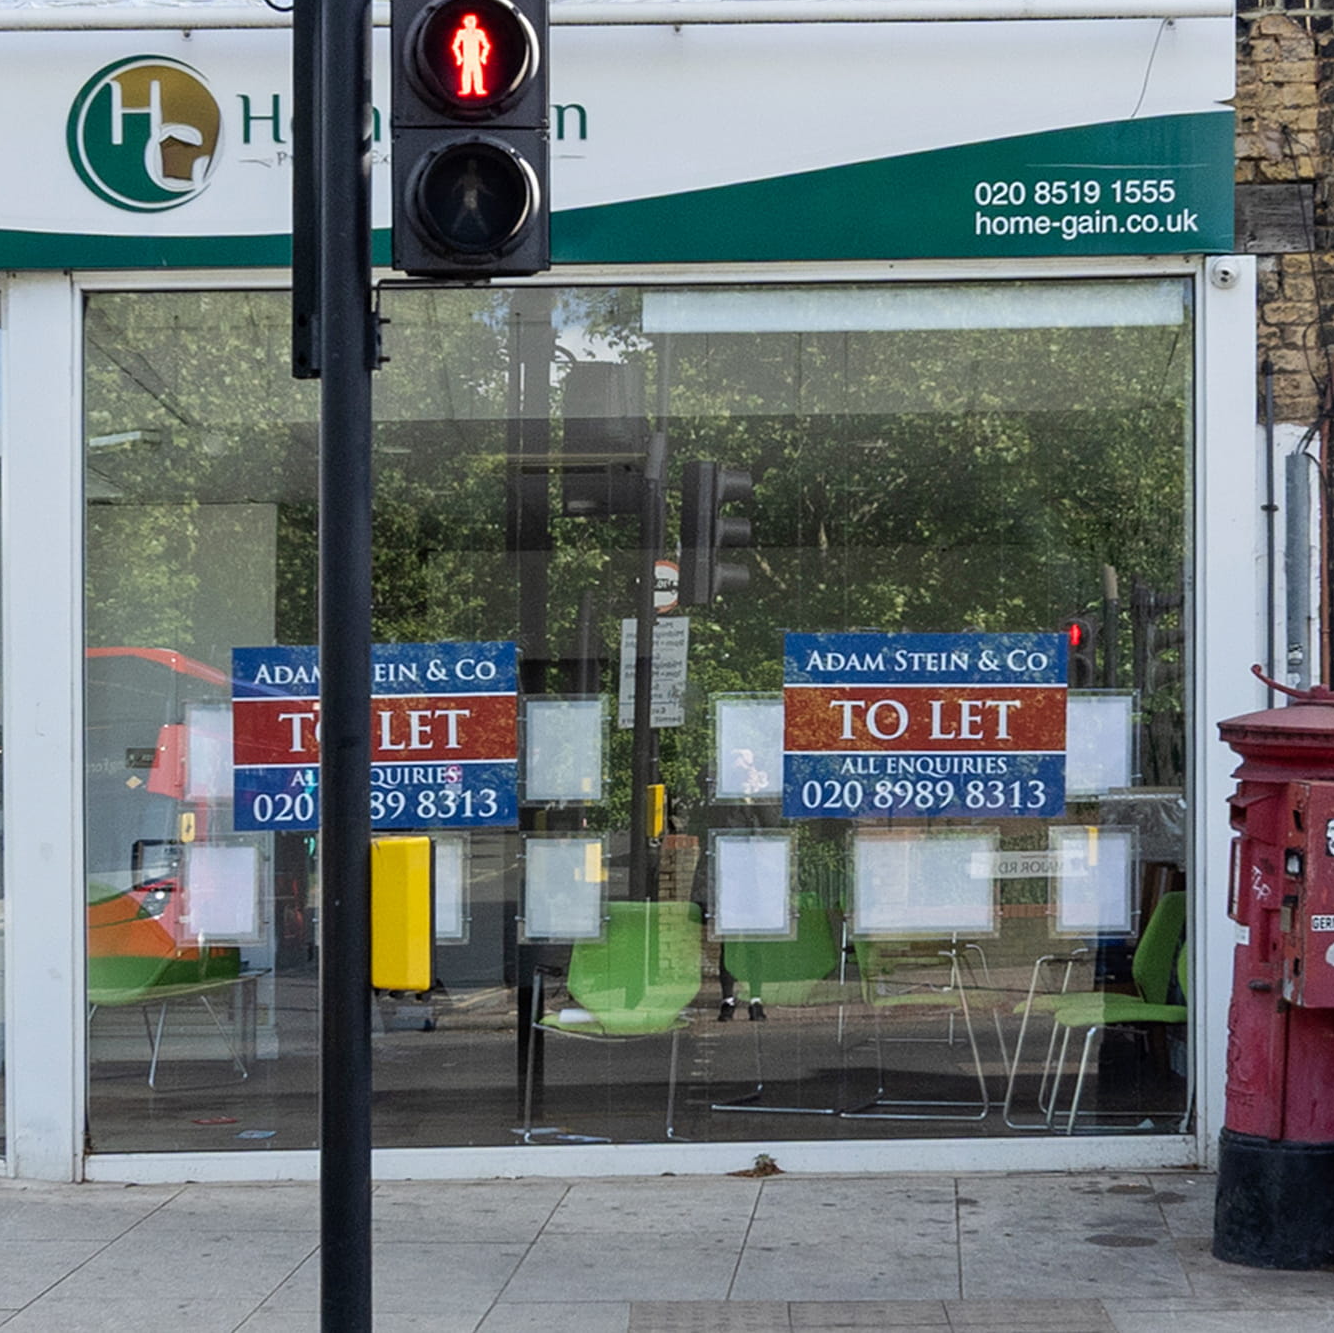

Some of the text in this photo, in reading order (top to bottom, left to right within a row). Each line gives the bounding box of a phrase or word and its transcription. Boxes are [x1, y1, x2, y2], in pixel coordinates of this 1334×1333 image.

[974, 179, 1176, 205] 020 8519 1555
[975, 208, 1199, 241] home-gain.co.uk
[374, 662, 417, 683] EIN
[426, 660, 448, 681] &
[978, 650, 1001, 672] &
[278, 709, 471, 753] T LET
[829, 699, 1022, 741] TO LET
[290, 765, 460, 789] AL QUIRIES
[841, 756, 1008, 778] ALL ENQUIRIES
[253, 788, 498, 822] 020 89 8313
[802, 780, 1046, 809] 020 8989 8313
